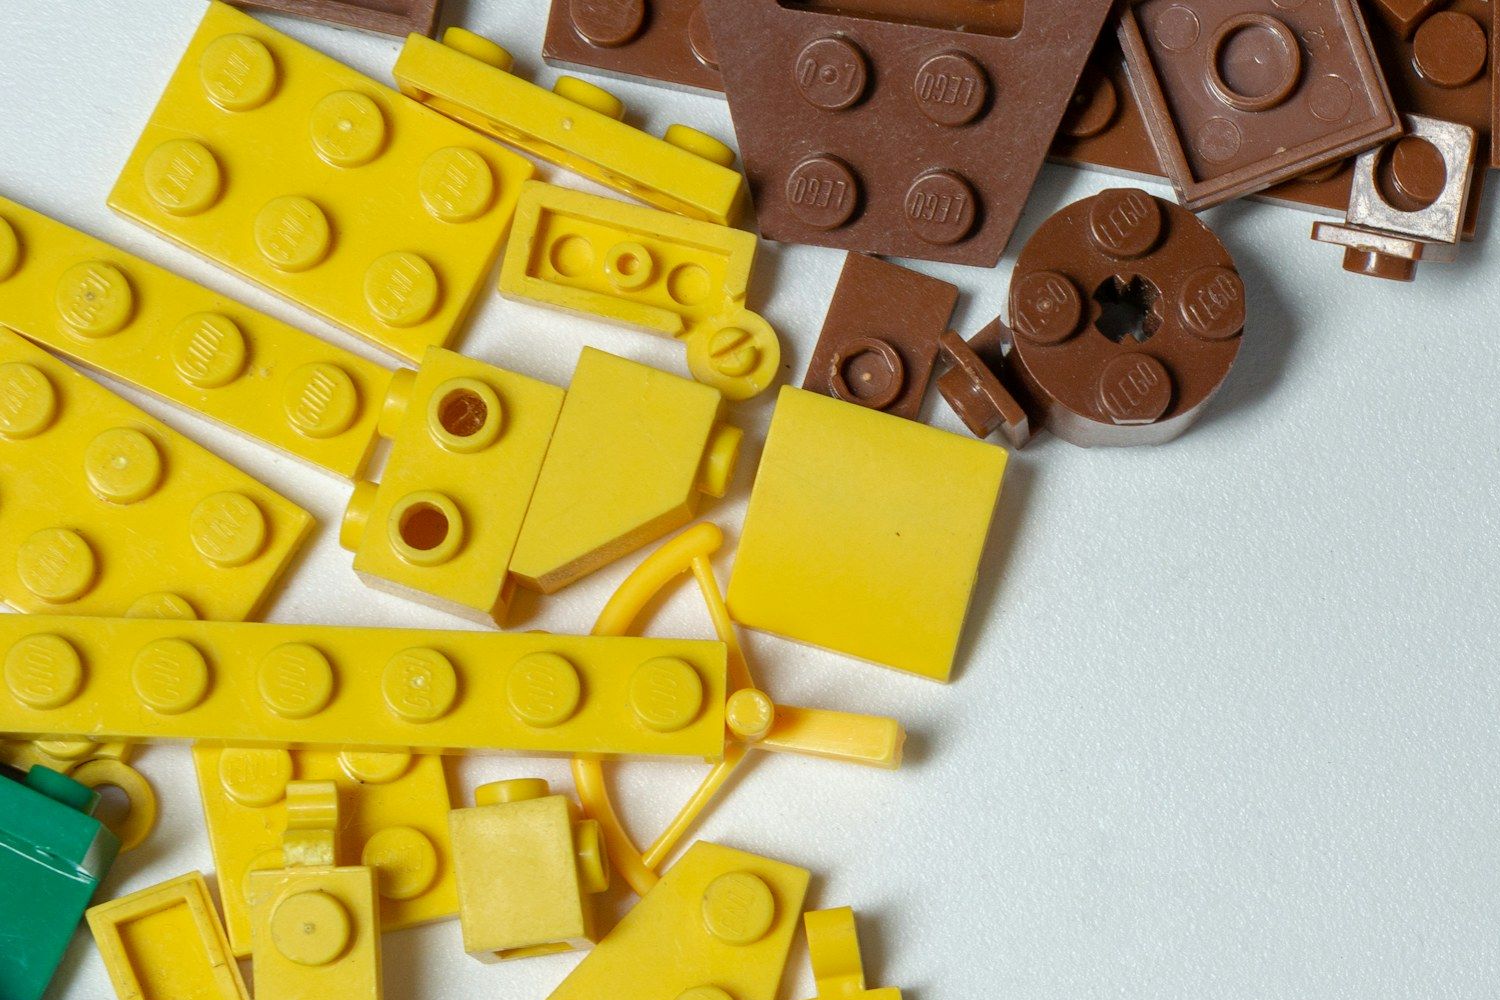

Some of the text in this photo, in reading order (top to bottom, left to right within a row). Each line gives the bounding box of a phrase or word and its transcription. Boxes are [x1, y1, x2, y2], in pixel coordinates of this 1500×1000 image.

[920, 72, 977, 106] LEGO
[790, 176, 848, 211] LEGO
[908, 190, 968, 225] LEGO
[1097, 190, 1149, 249] LEGO
[1187, 273, 1240, 331] LEGO
[1106, 361, 1160, 416] LEGO
